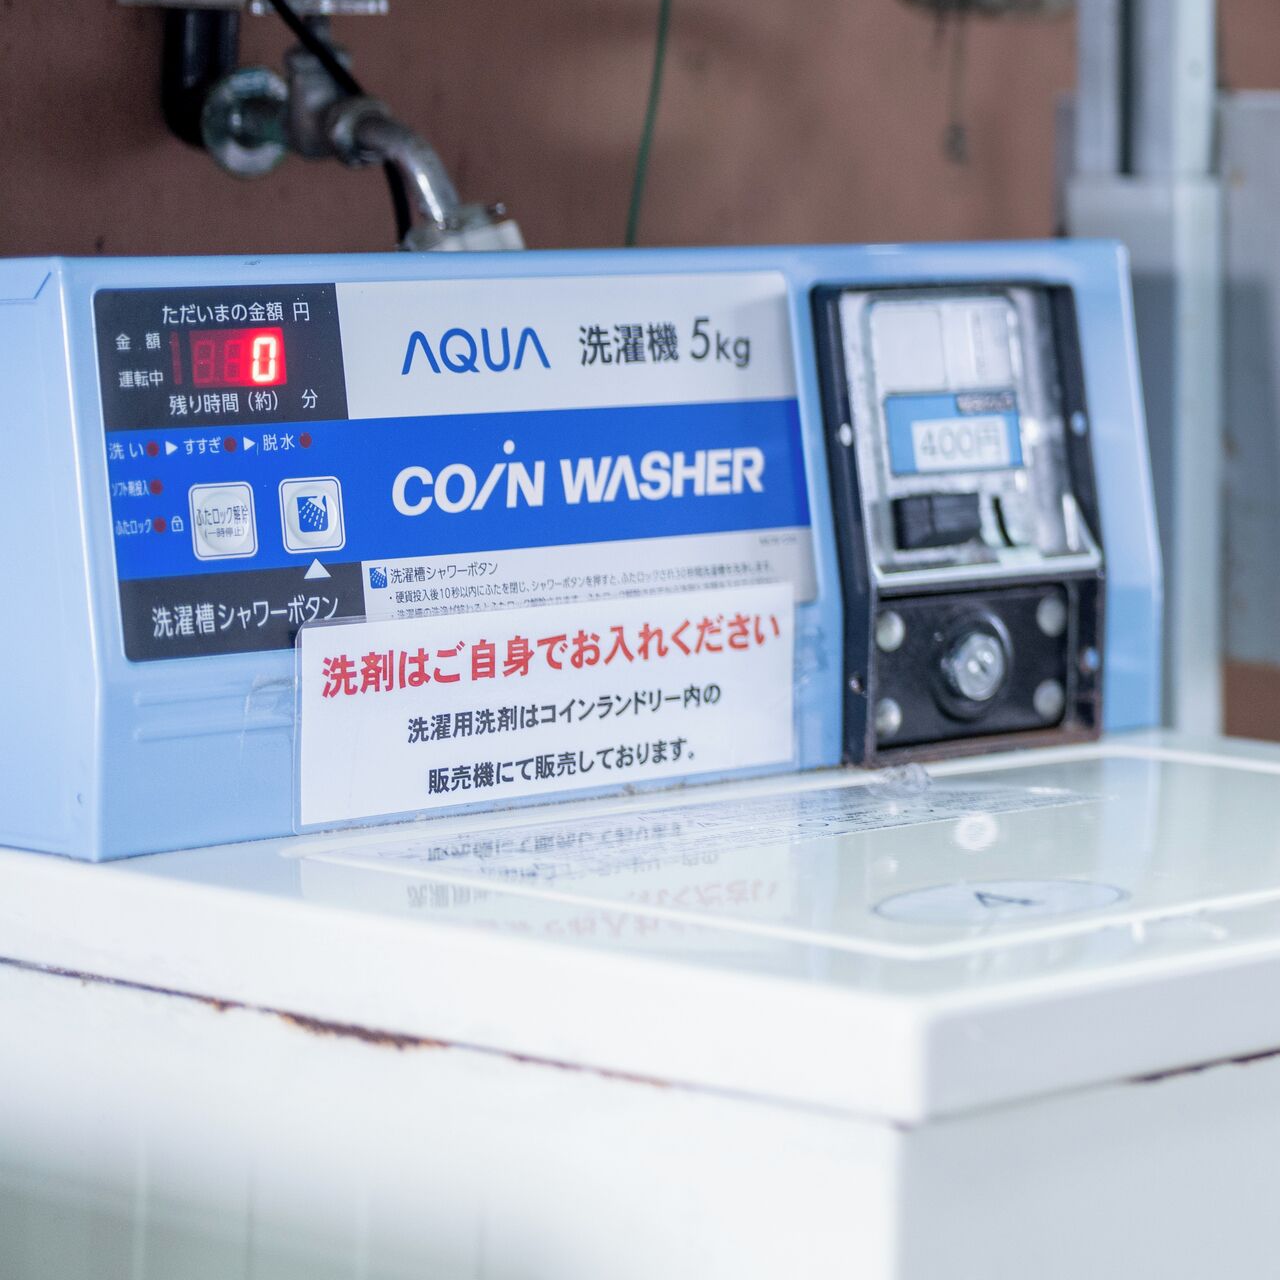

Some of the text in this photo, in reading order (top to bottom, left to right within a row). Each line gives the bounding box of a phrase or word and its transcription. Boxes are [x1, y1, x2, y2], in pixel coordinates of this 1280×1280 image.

[162, 302, 310, 325] ただいまの金額 円
[252, 337, 277, 383] 0
[401, 327, 551, 375] AQUA
[578, 317, 752, 368] 洗濯機 5kg
[118, 370, 164, 388] 運転中
[301, 389, 318, 408] 分
[183, 437, 222, 455] すすぎ
[262, 433, 296, 452] 脱水
[560, 447, 766, 505] WASHER
[390, 562, 499, 584] 洗濯槽シャワーボタン
[152, 594, 340, 638] 洗濯槽シャワーボタン
[321, 613, 780, 699] 洗剤はご自身でお入れください
[407, 683, 721, 744] 洗濯用洗剤はコインランドリー内の
[428, 738, 696, 795] 販売機にて販売しております。
